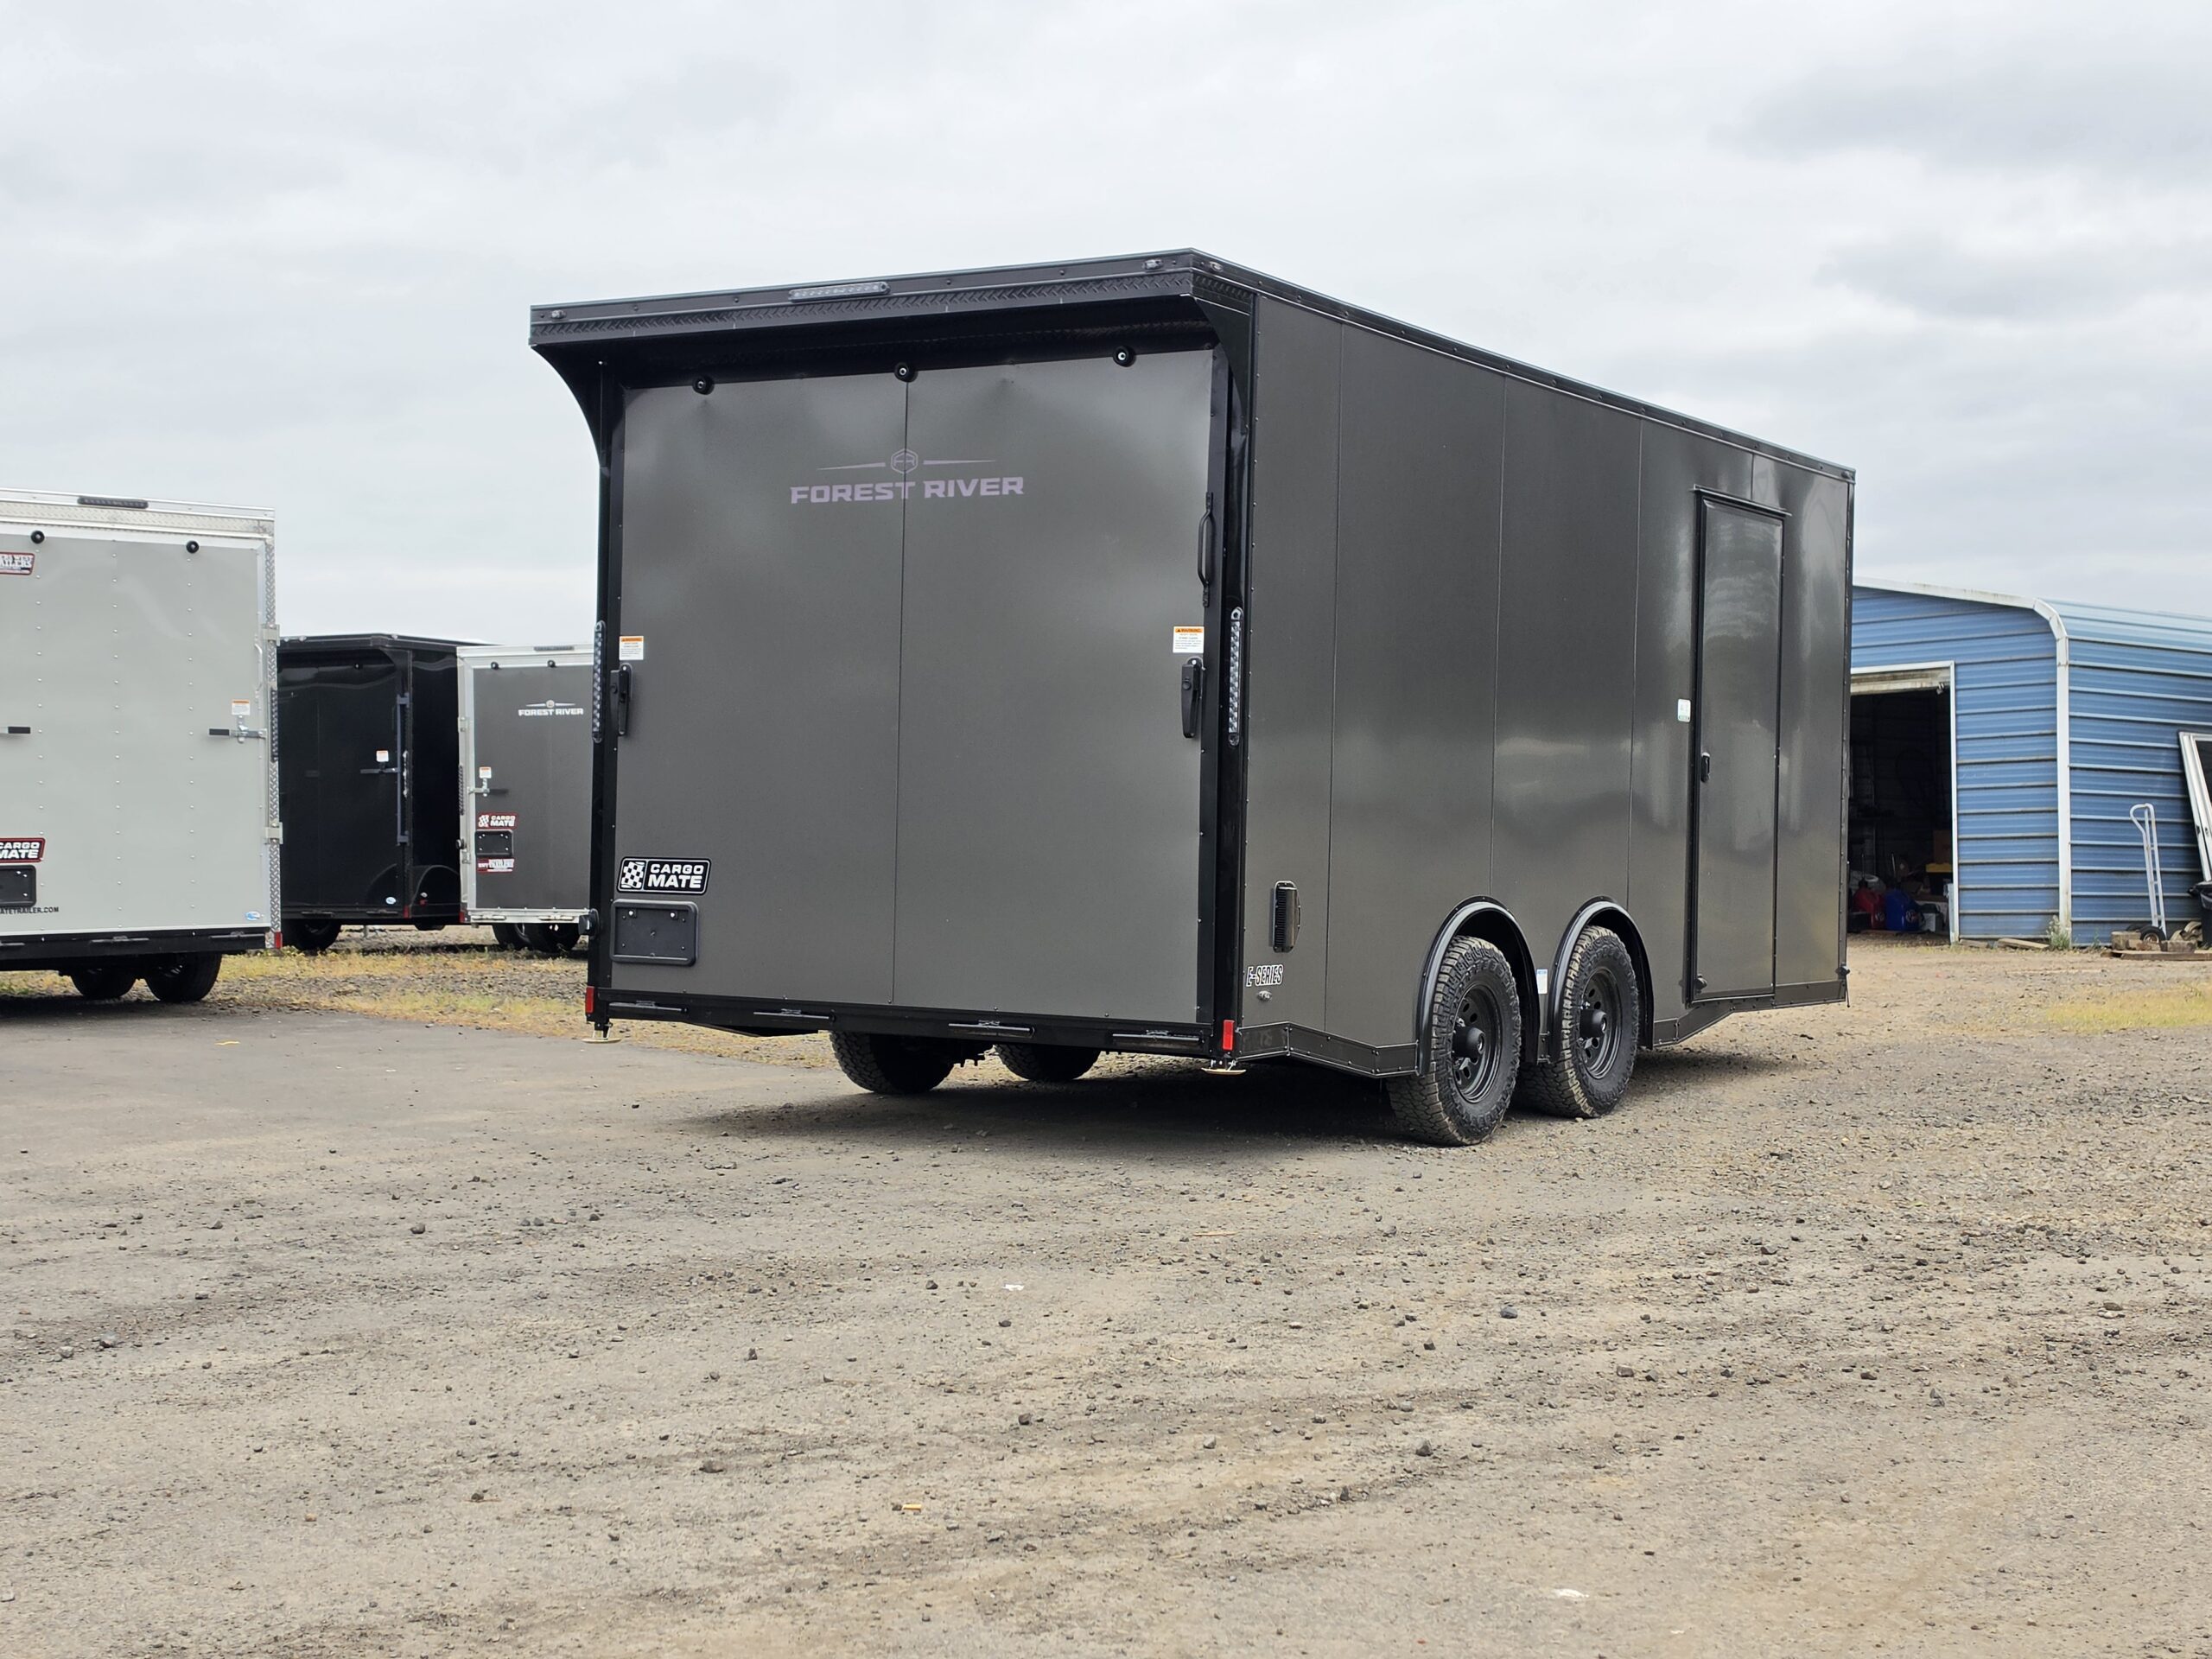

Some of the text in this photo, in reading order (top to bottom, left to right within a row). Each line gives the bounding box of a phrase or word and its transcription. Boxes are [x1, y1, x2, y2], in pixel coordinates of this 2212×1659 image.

[790, 476, 1024, 504] FOREST RIVER
[650, 863, 704, 874] CARGO
[647, 874, 702, 888] MATE
[1246, 964, 1284, 987] E-SERIES
